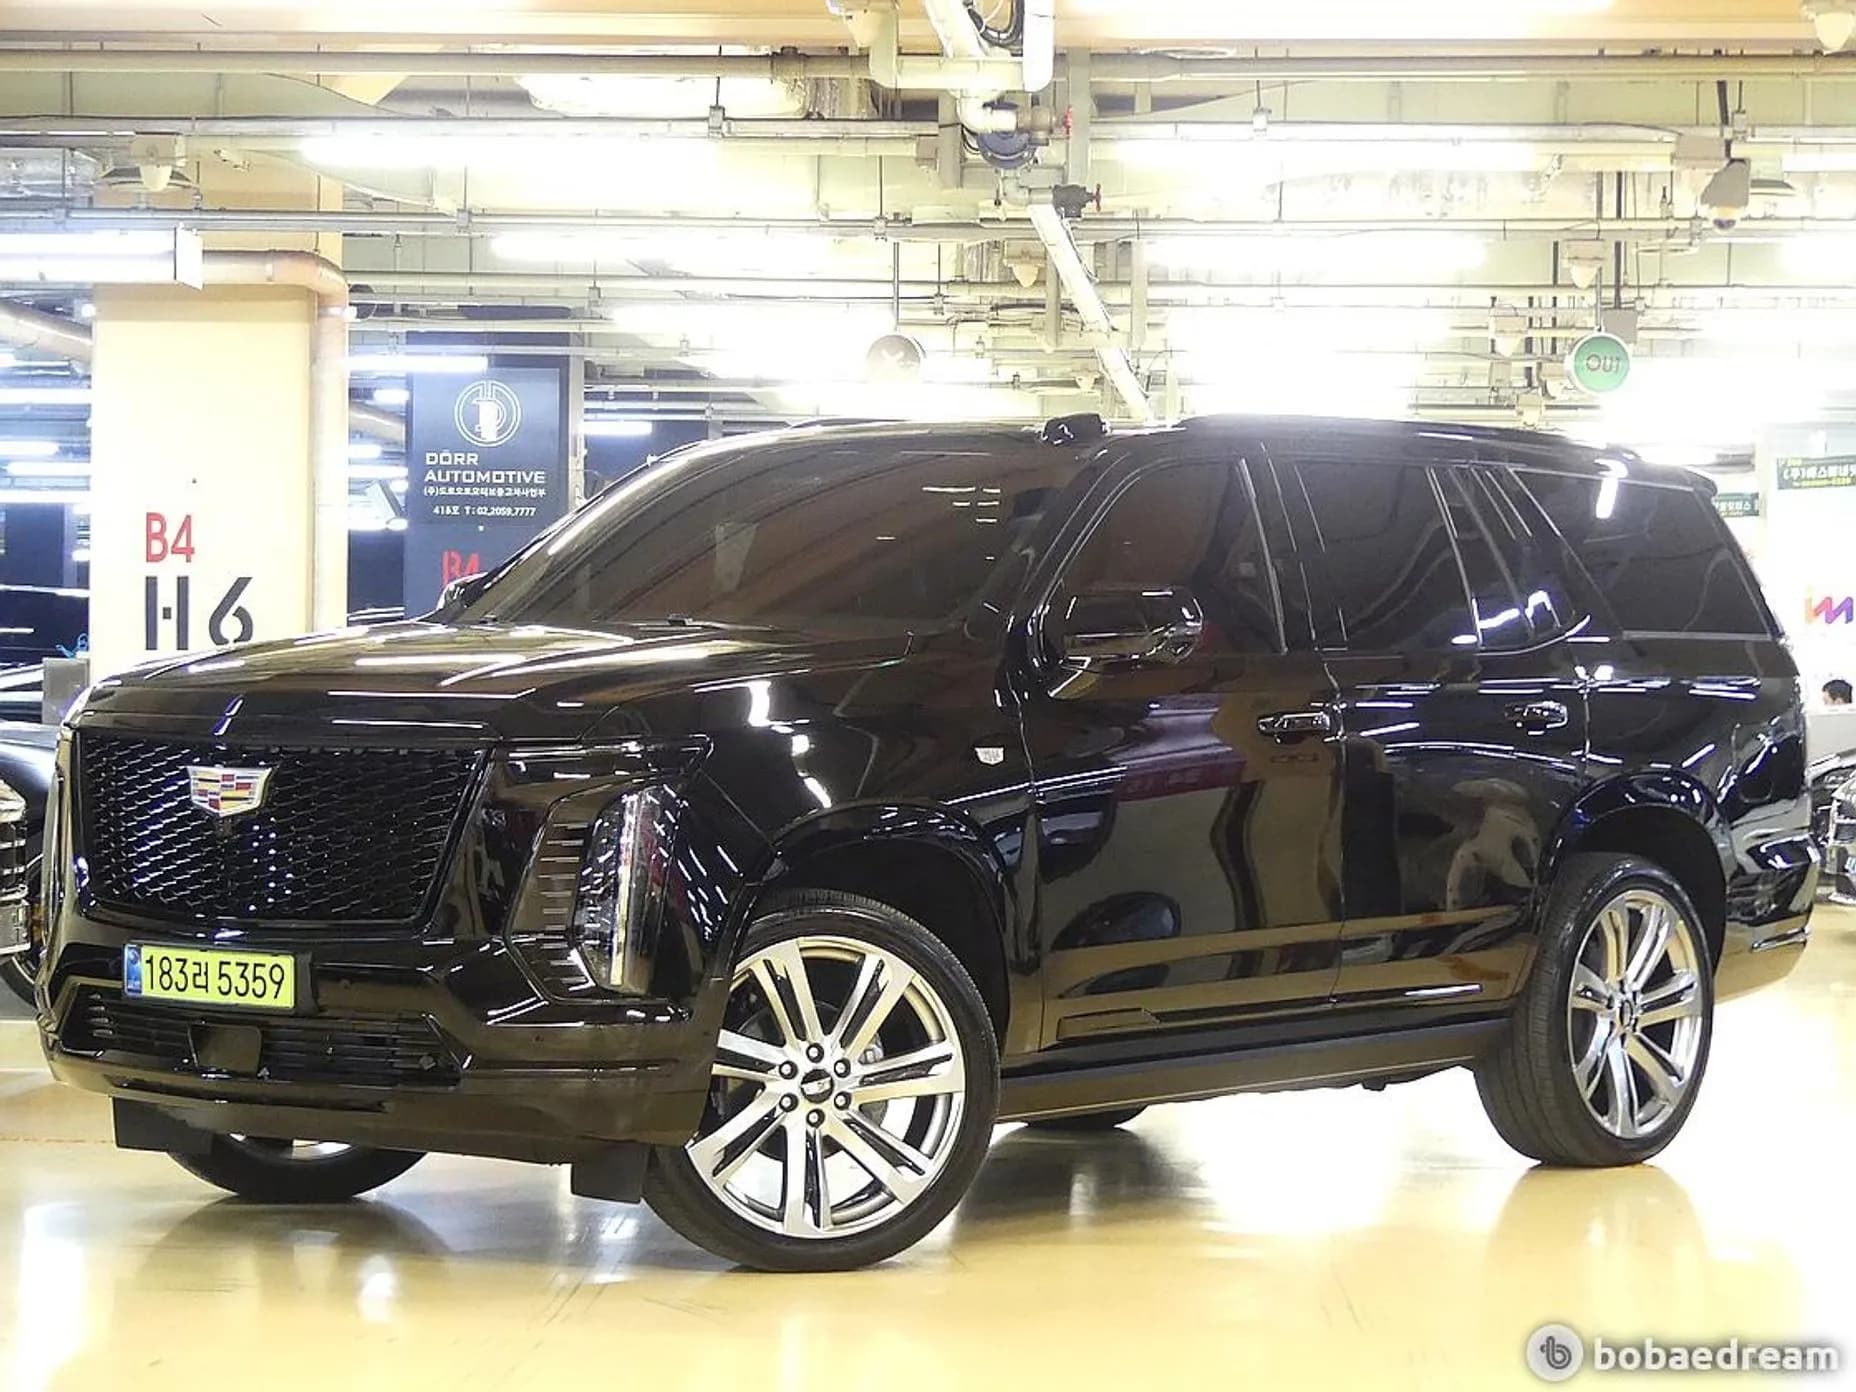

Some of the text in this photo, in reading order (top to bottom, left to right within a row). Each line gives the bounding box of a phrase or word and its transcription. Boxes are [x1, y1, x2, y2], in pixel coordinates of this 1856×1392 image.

[1586, 354, 1620, 374] OUT
[424, 470, 546, 484] AUTOMOTIVE
[145, 512, 196, 563] B4
[145, 955, 286, 1000] 183러 5359
